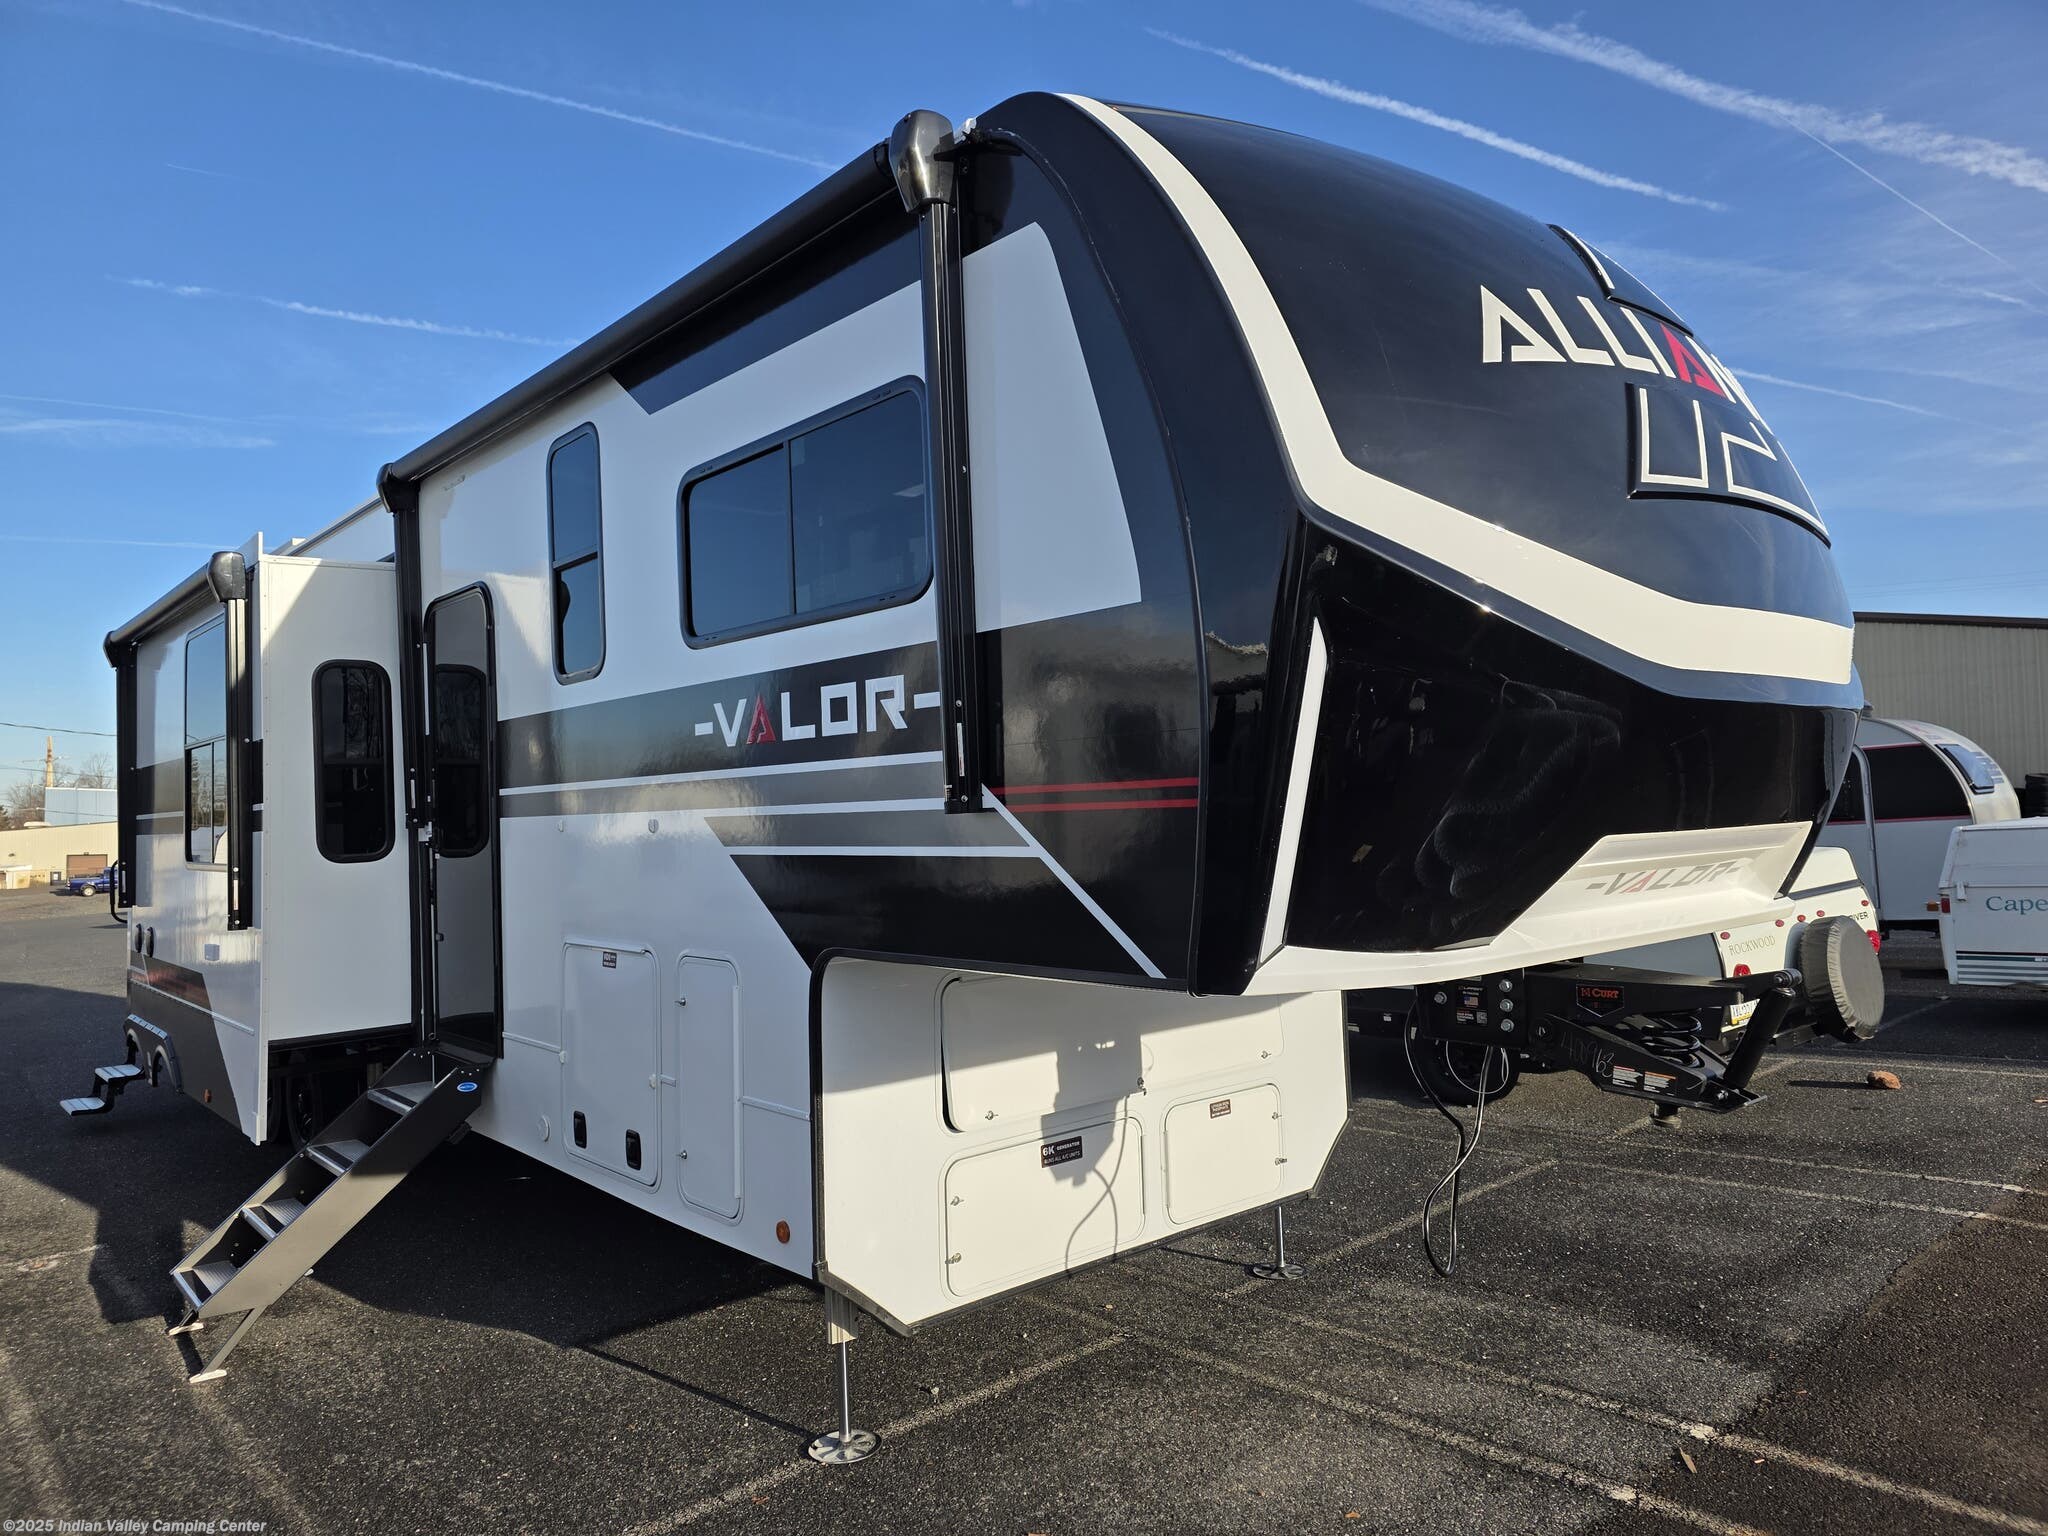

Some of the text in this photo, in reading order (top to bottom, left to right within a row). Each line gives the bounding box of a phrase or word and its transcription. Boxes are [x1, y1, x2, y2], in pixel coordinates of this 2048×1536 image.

[1985, 895, 2048, 915] Cape
[1728, 935, 1776, 956] ROCKWOOD
[1042, 1145, 1055, 1157] 6K
